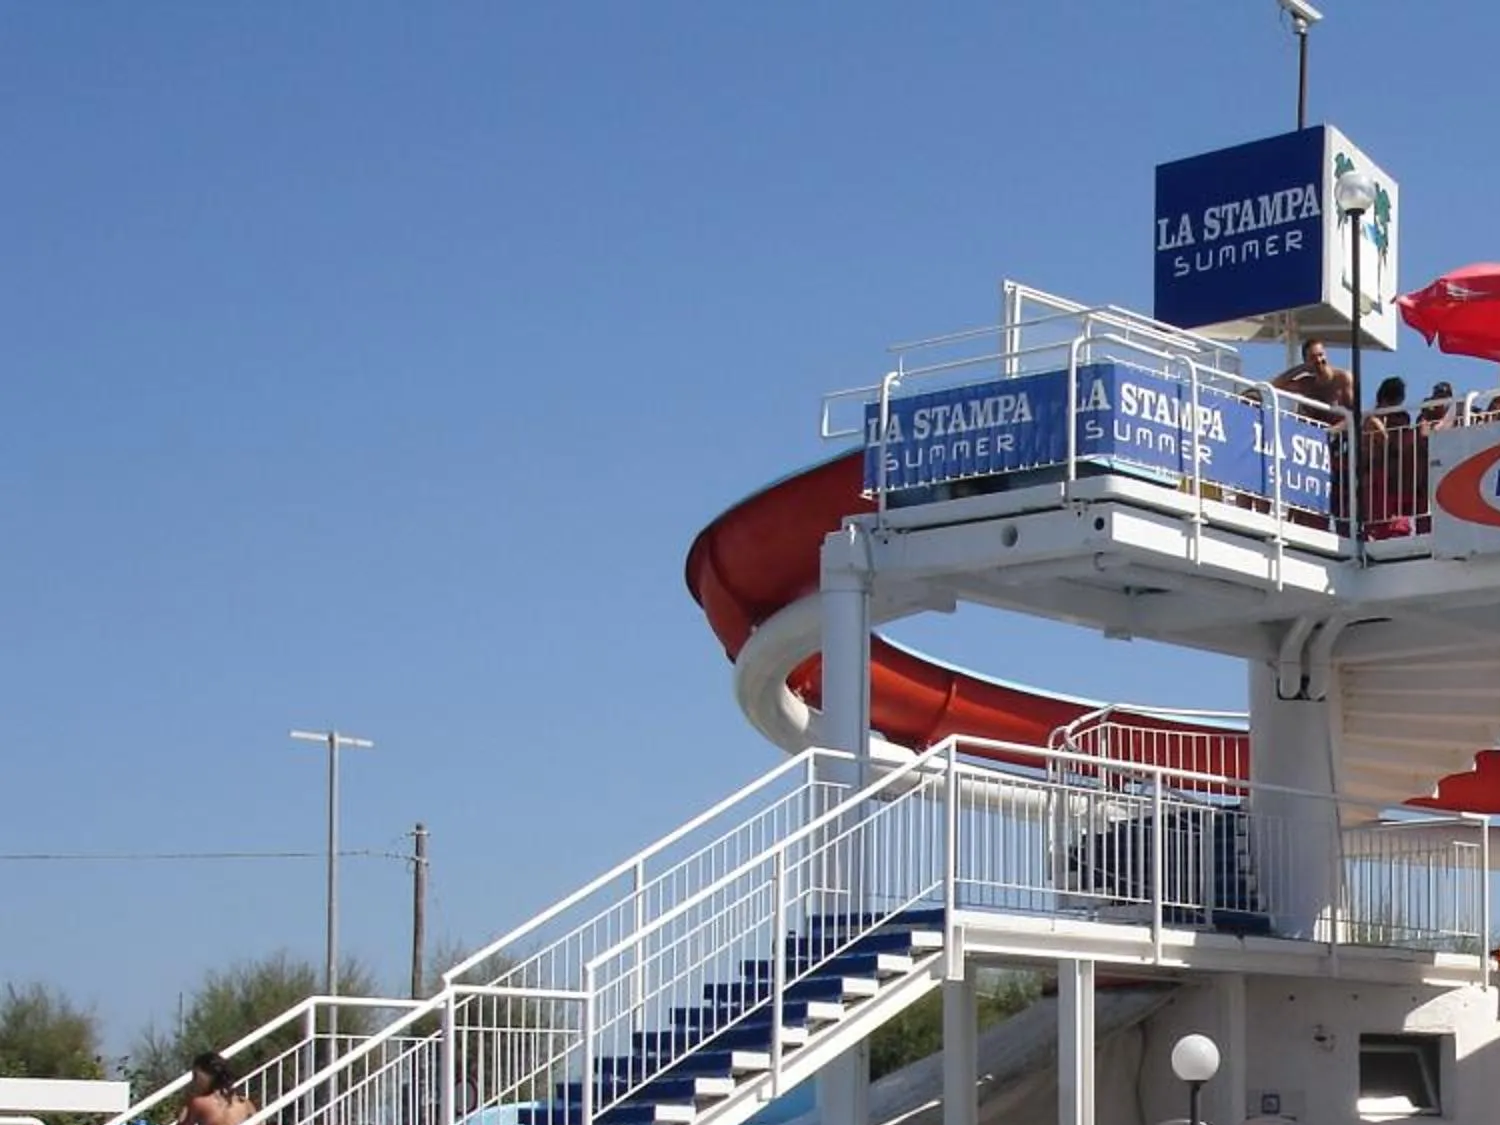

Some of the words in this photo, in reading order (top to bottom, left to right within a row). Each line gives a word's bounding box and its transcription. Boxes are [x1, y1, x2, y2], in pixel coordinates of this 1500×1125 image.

[1157, 213, 1195, 251] LA
[1202, 183, 1321, 242] STAMPA
[1173, 229, 1304, 277] SUMMER
[913, 392, 1033, 440] STAMPA
[1121, 382, 1227, 443] STAMPA
[885, 433, 1015, 471] SUMMER
[1085, 418, 1213, 466] SUMMER
